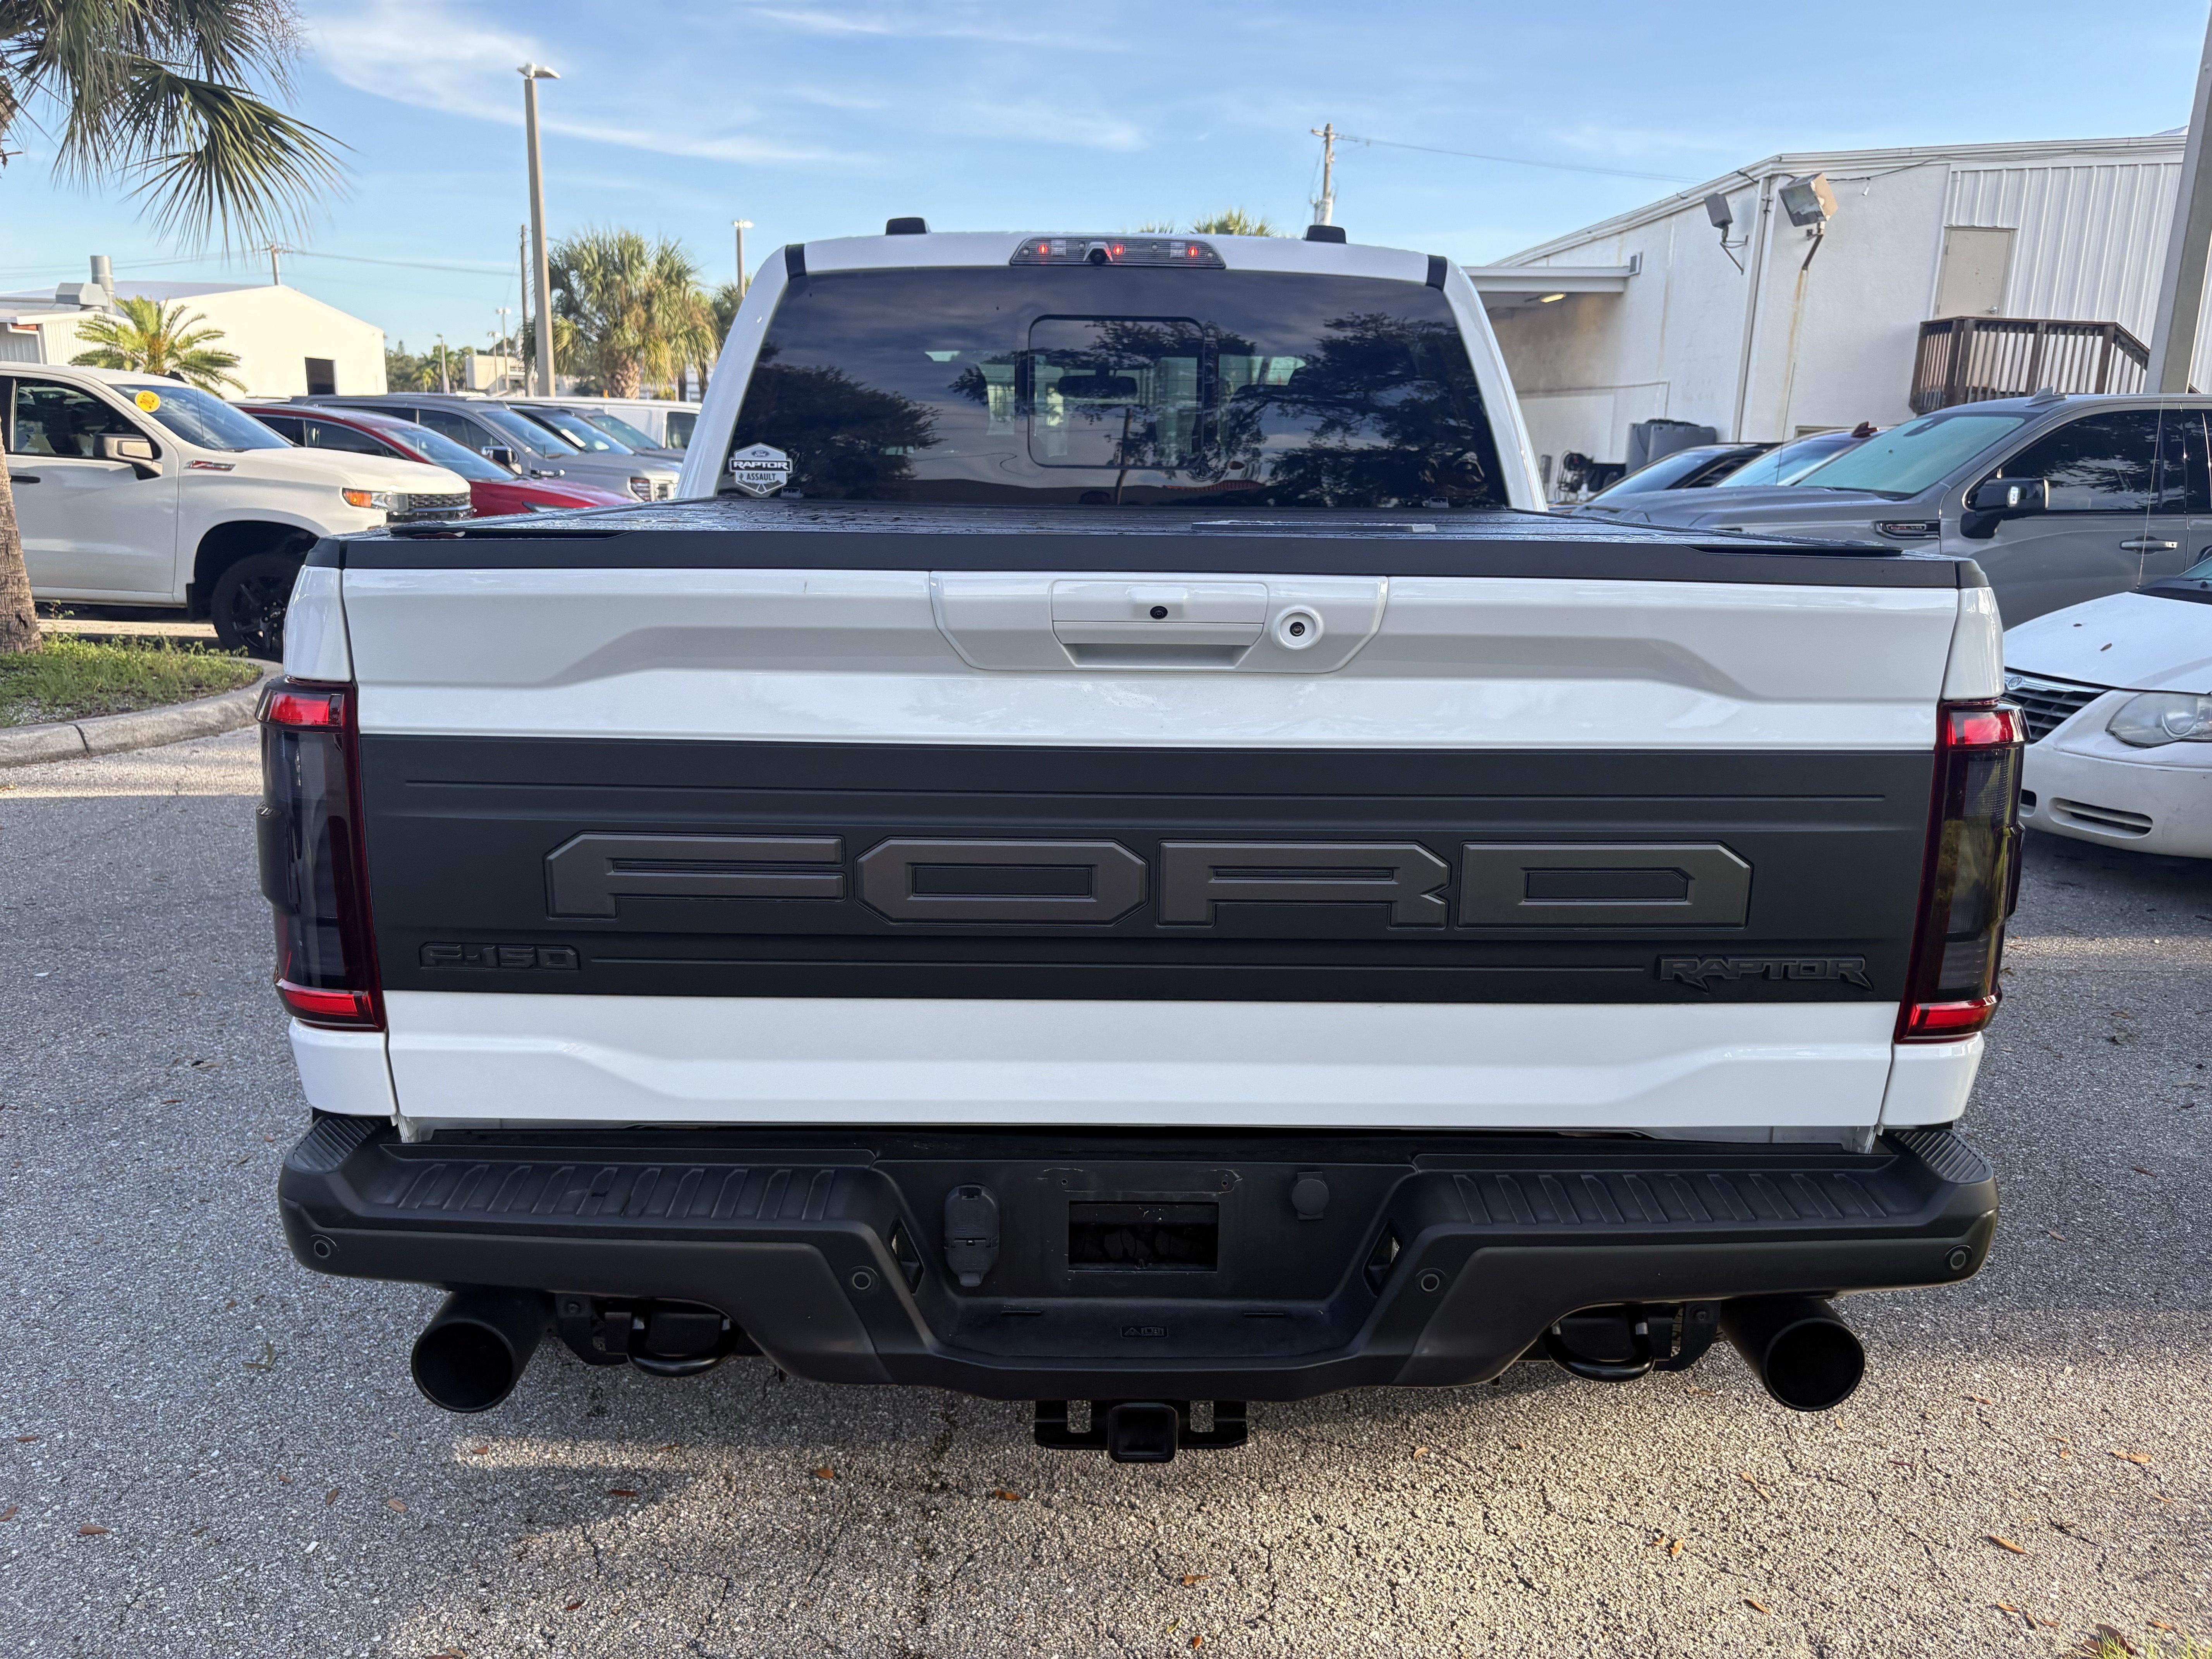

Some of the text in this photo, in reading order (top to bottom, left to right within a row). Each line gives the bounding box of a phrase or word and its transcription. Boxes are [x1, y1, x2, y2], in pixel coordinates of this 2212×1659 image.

[733, 461, 789, 470] RAPTOR
[747, 473, 776, 481] ASSAULT
[545, 831, 1753, 931] FORD
[419, 941, 580, 970] F-150
[1656, 954, 1874, 992] RAPTOR
